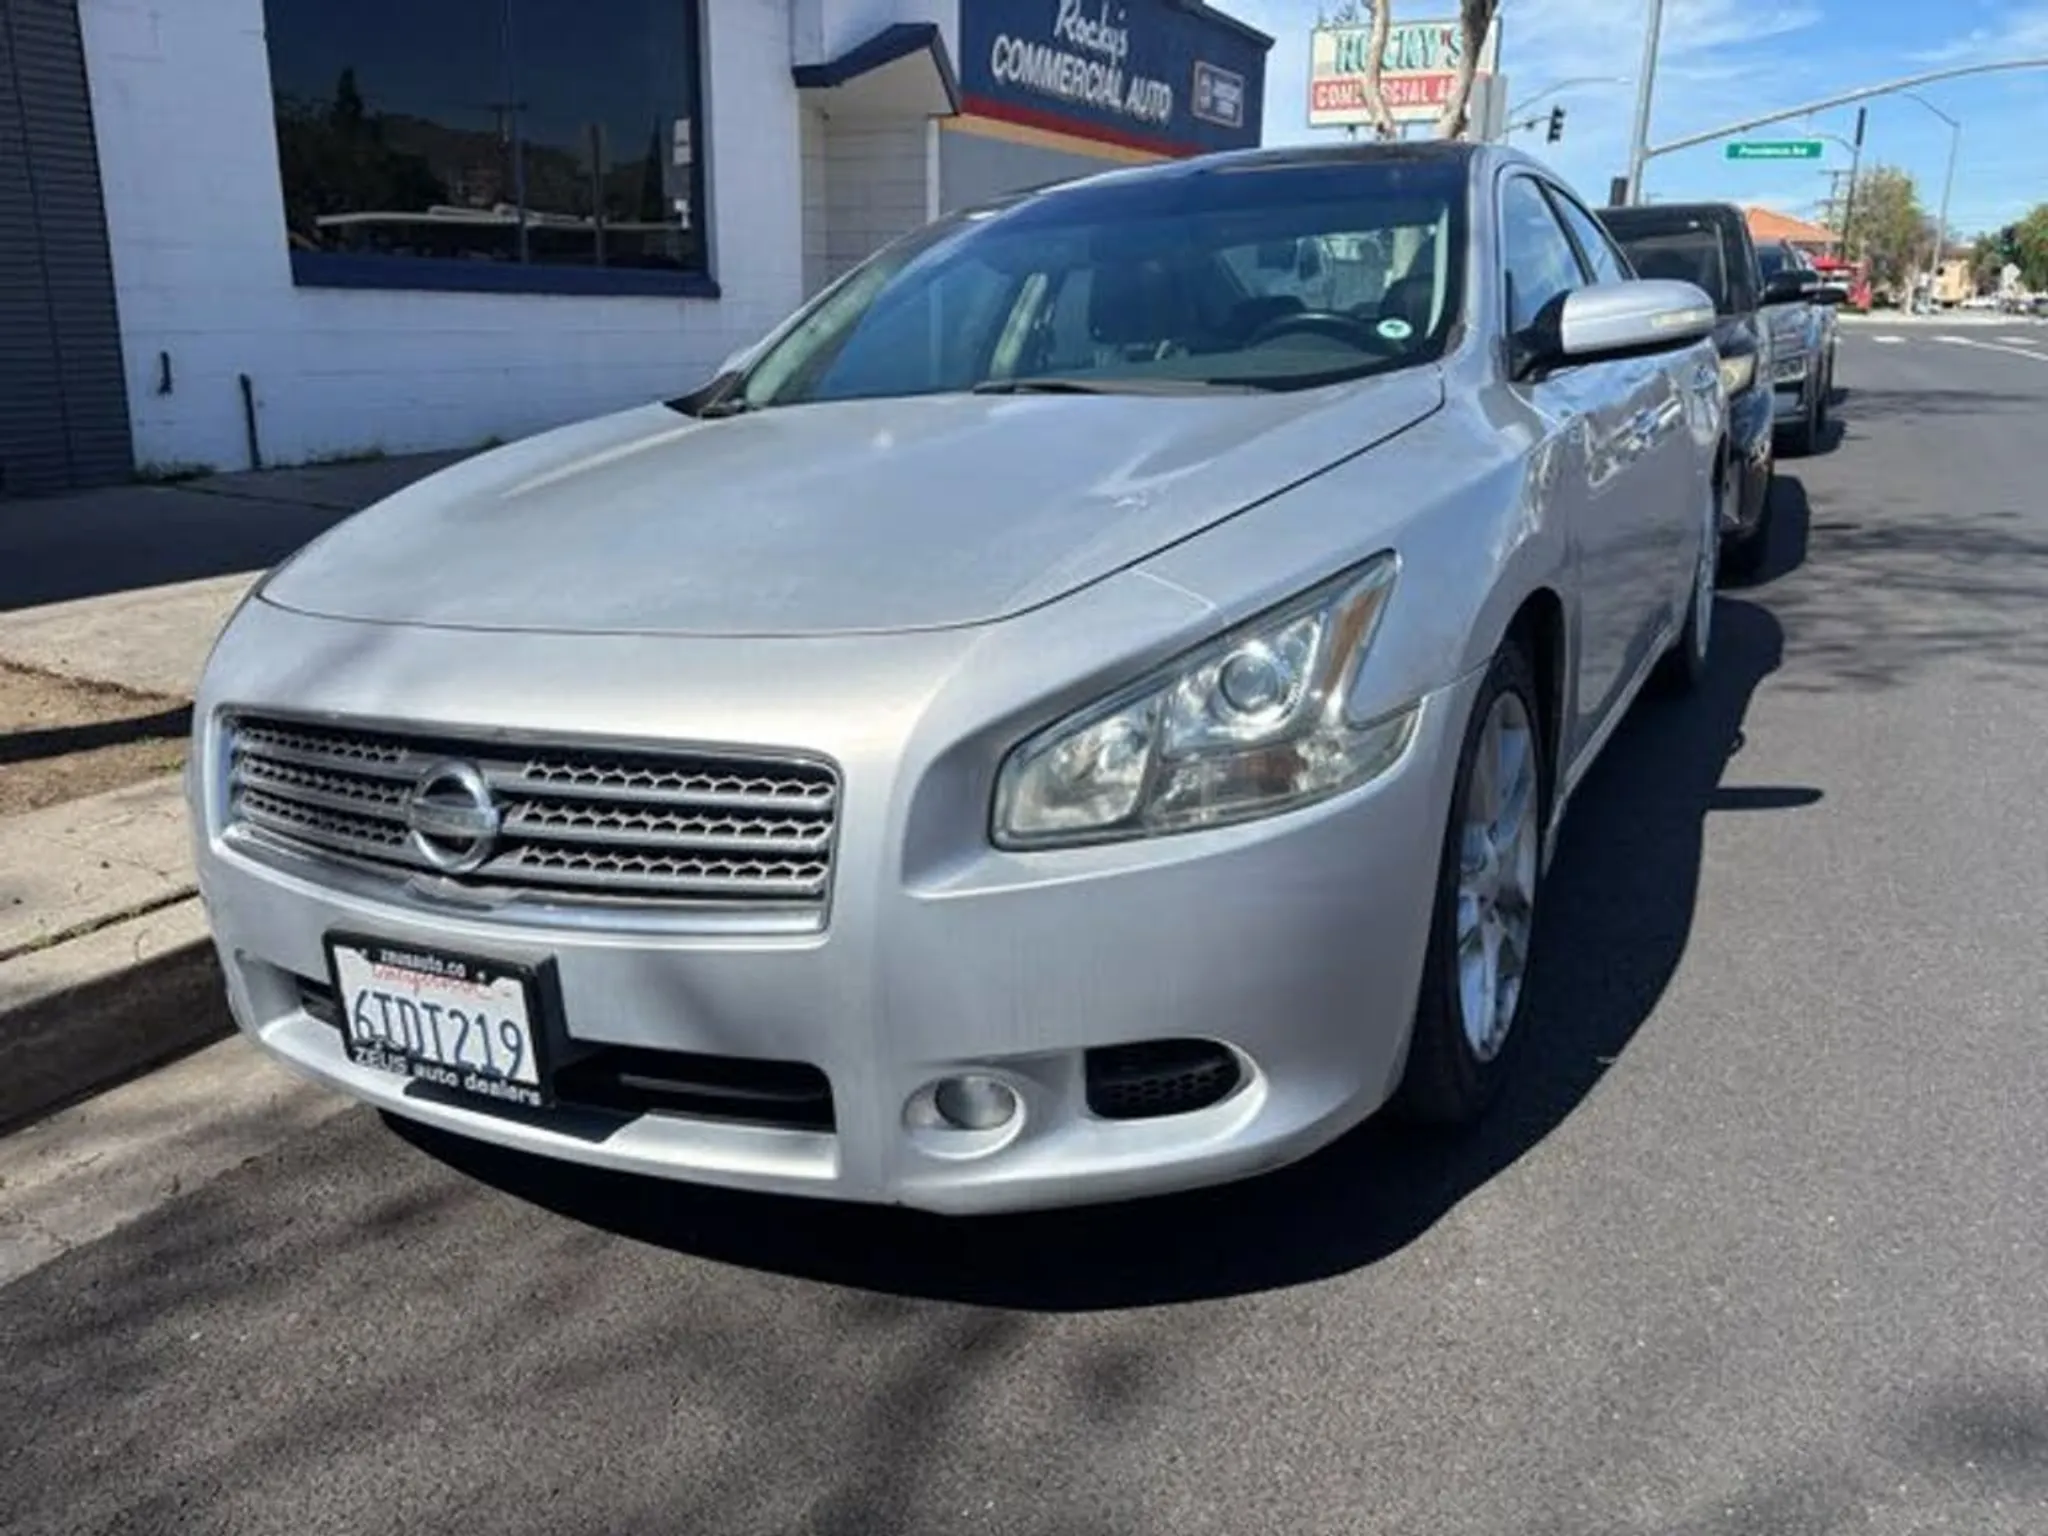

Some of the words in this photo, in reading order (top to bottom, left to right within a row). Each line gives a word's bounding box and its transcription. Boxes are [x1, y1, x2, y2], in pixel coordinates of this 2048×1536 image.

[1054, 0, 1128, 65] Rocky's
[991, 33, 1124, 108] COMMERCIAL
[1126, 76, 1173, 121] AUTO
[354, 1047, 408, 1076] ZEUS
[414, 1063, 460, 1087] auto
[463, 1072, 542, 1106] dealers
